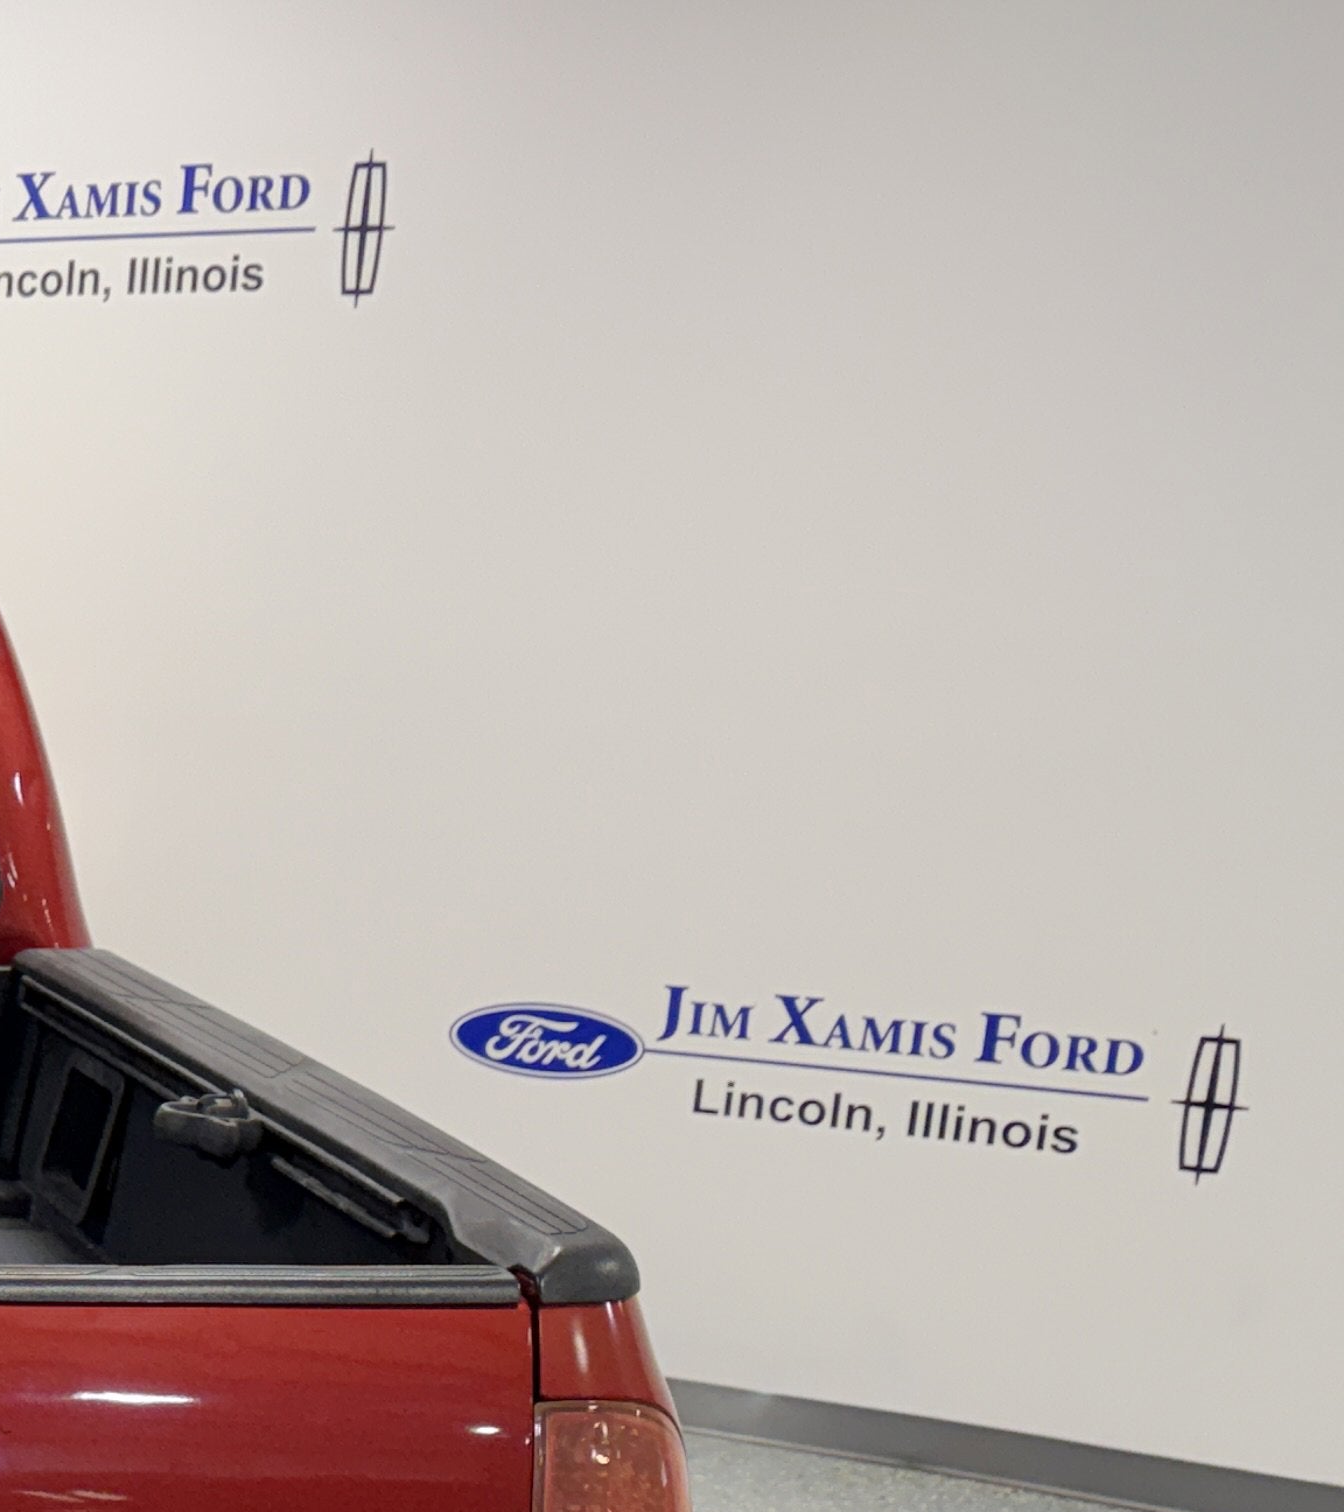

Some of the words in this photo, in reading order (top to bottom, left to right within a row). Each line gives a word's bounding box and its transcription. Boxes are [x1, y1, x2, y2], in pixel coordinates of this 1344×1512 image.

[12, 171, 162, 224] XAMIS
[177, 163, 310, 215] FORD
[126, 255, 264, 294] Illinois
[485, 1015, 604, 1072] Ford
[656, 985, 753, 1041] JIM
[769, 994, 957, 1060] XAMIS
[973, 1011, 1145, 1077] FORD
[692, 1078, 887, 1141] Lincoln,
[906, 1101, 1079, 1155] Illinois
